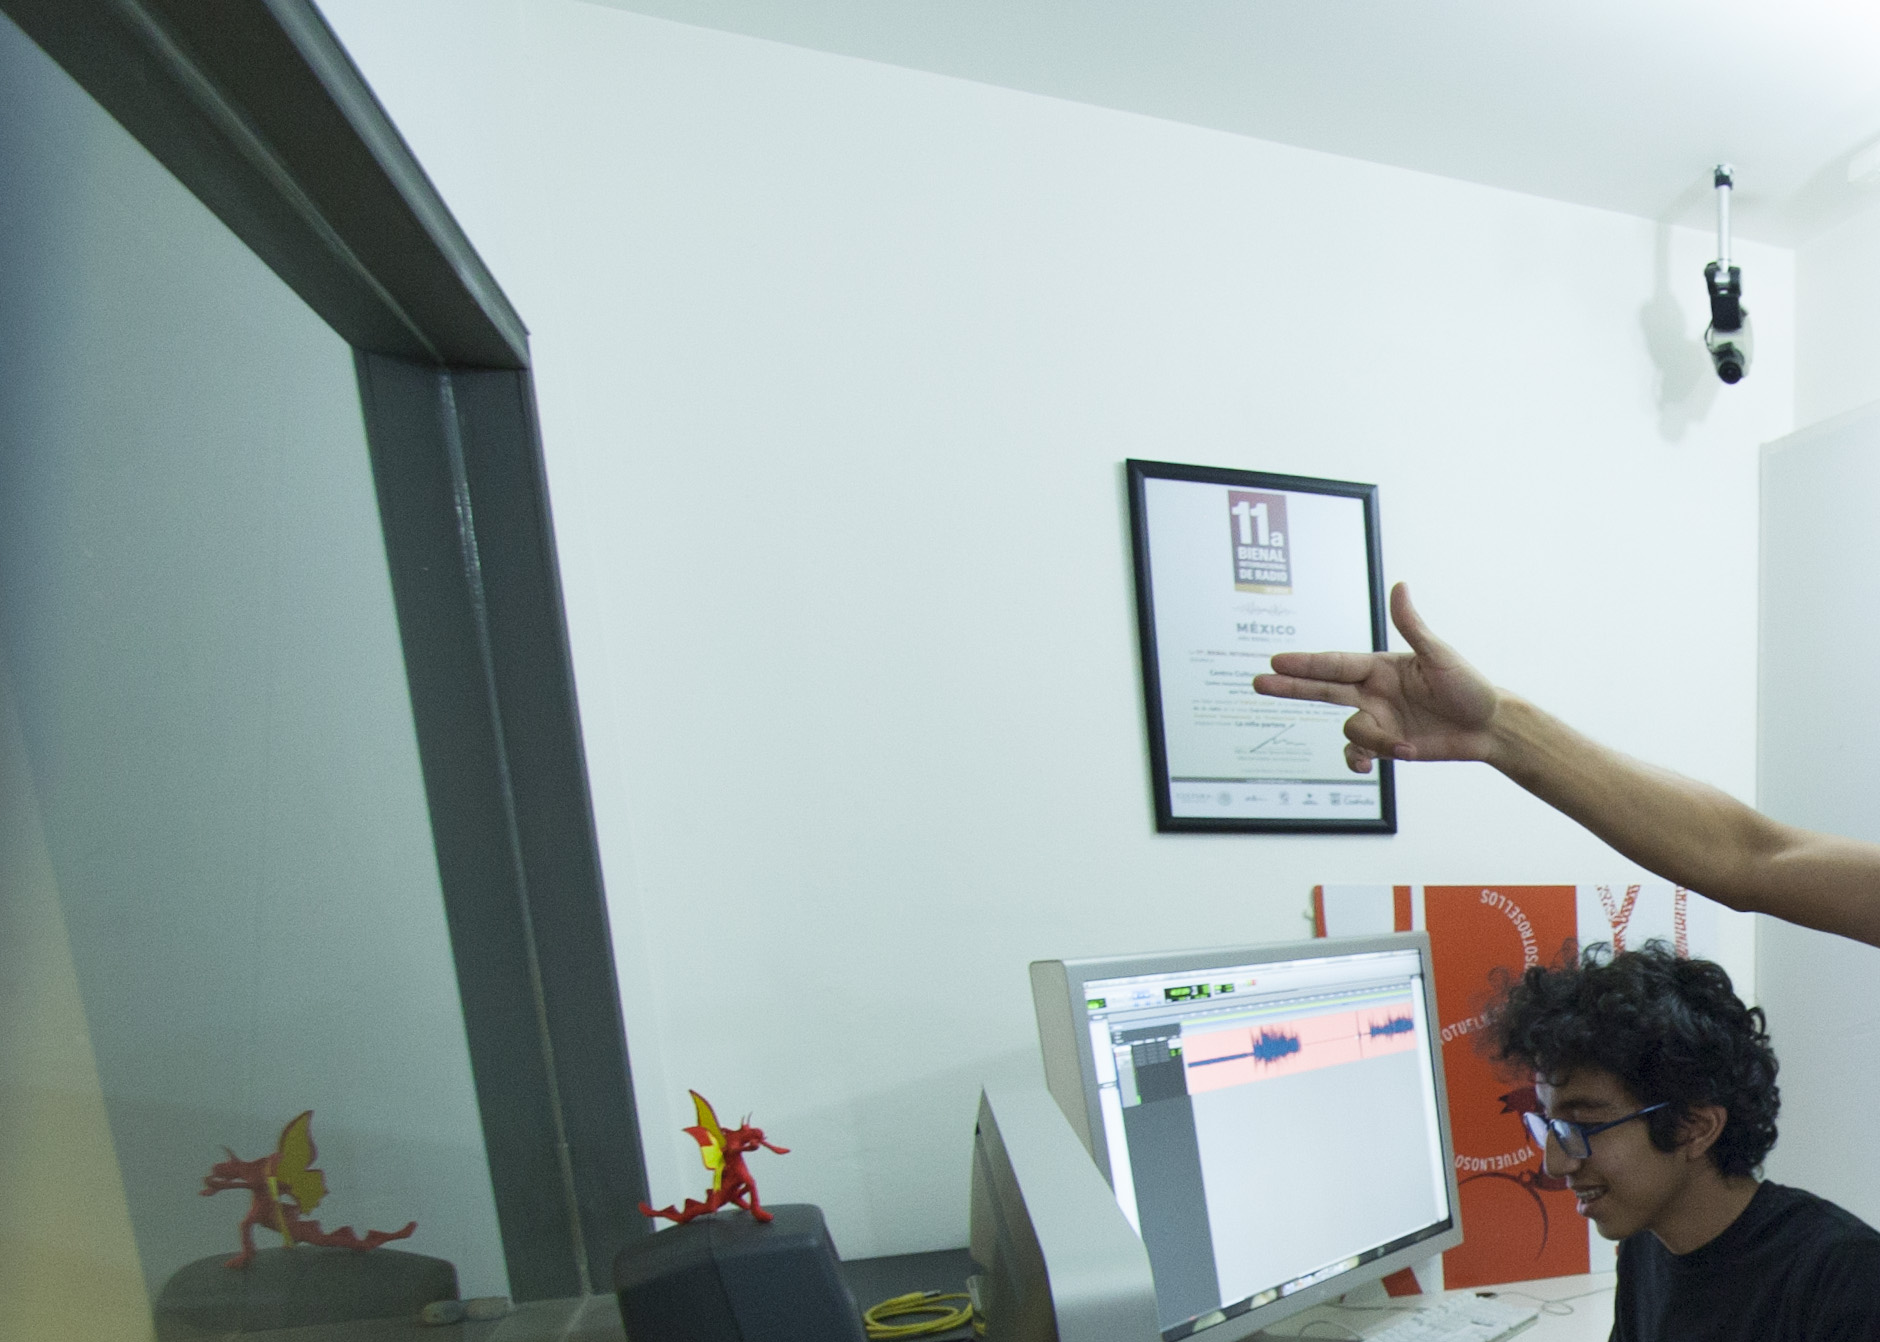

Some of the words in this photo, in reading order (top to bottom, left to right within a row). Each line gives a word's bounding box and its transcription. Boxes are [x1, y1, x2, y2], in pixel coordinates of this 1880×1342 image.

[1231, 501, 1284, 547] 11a
[1238, 546, 1286, 563] BIENAL
[1239, 568, 1254, 581] DE
[1255, 570, 1288, 583] RADIO
[1236, 622, 1297, 636] MÉXICO
